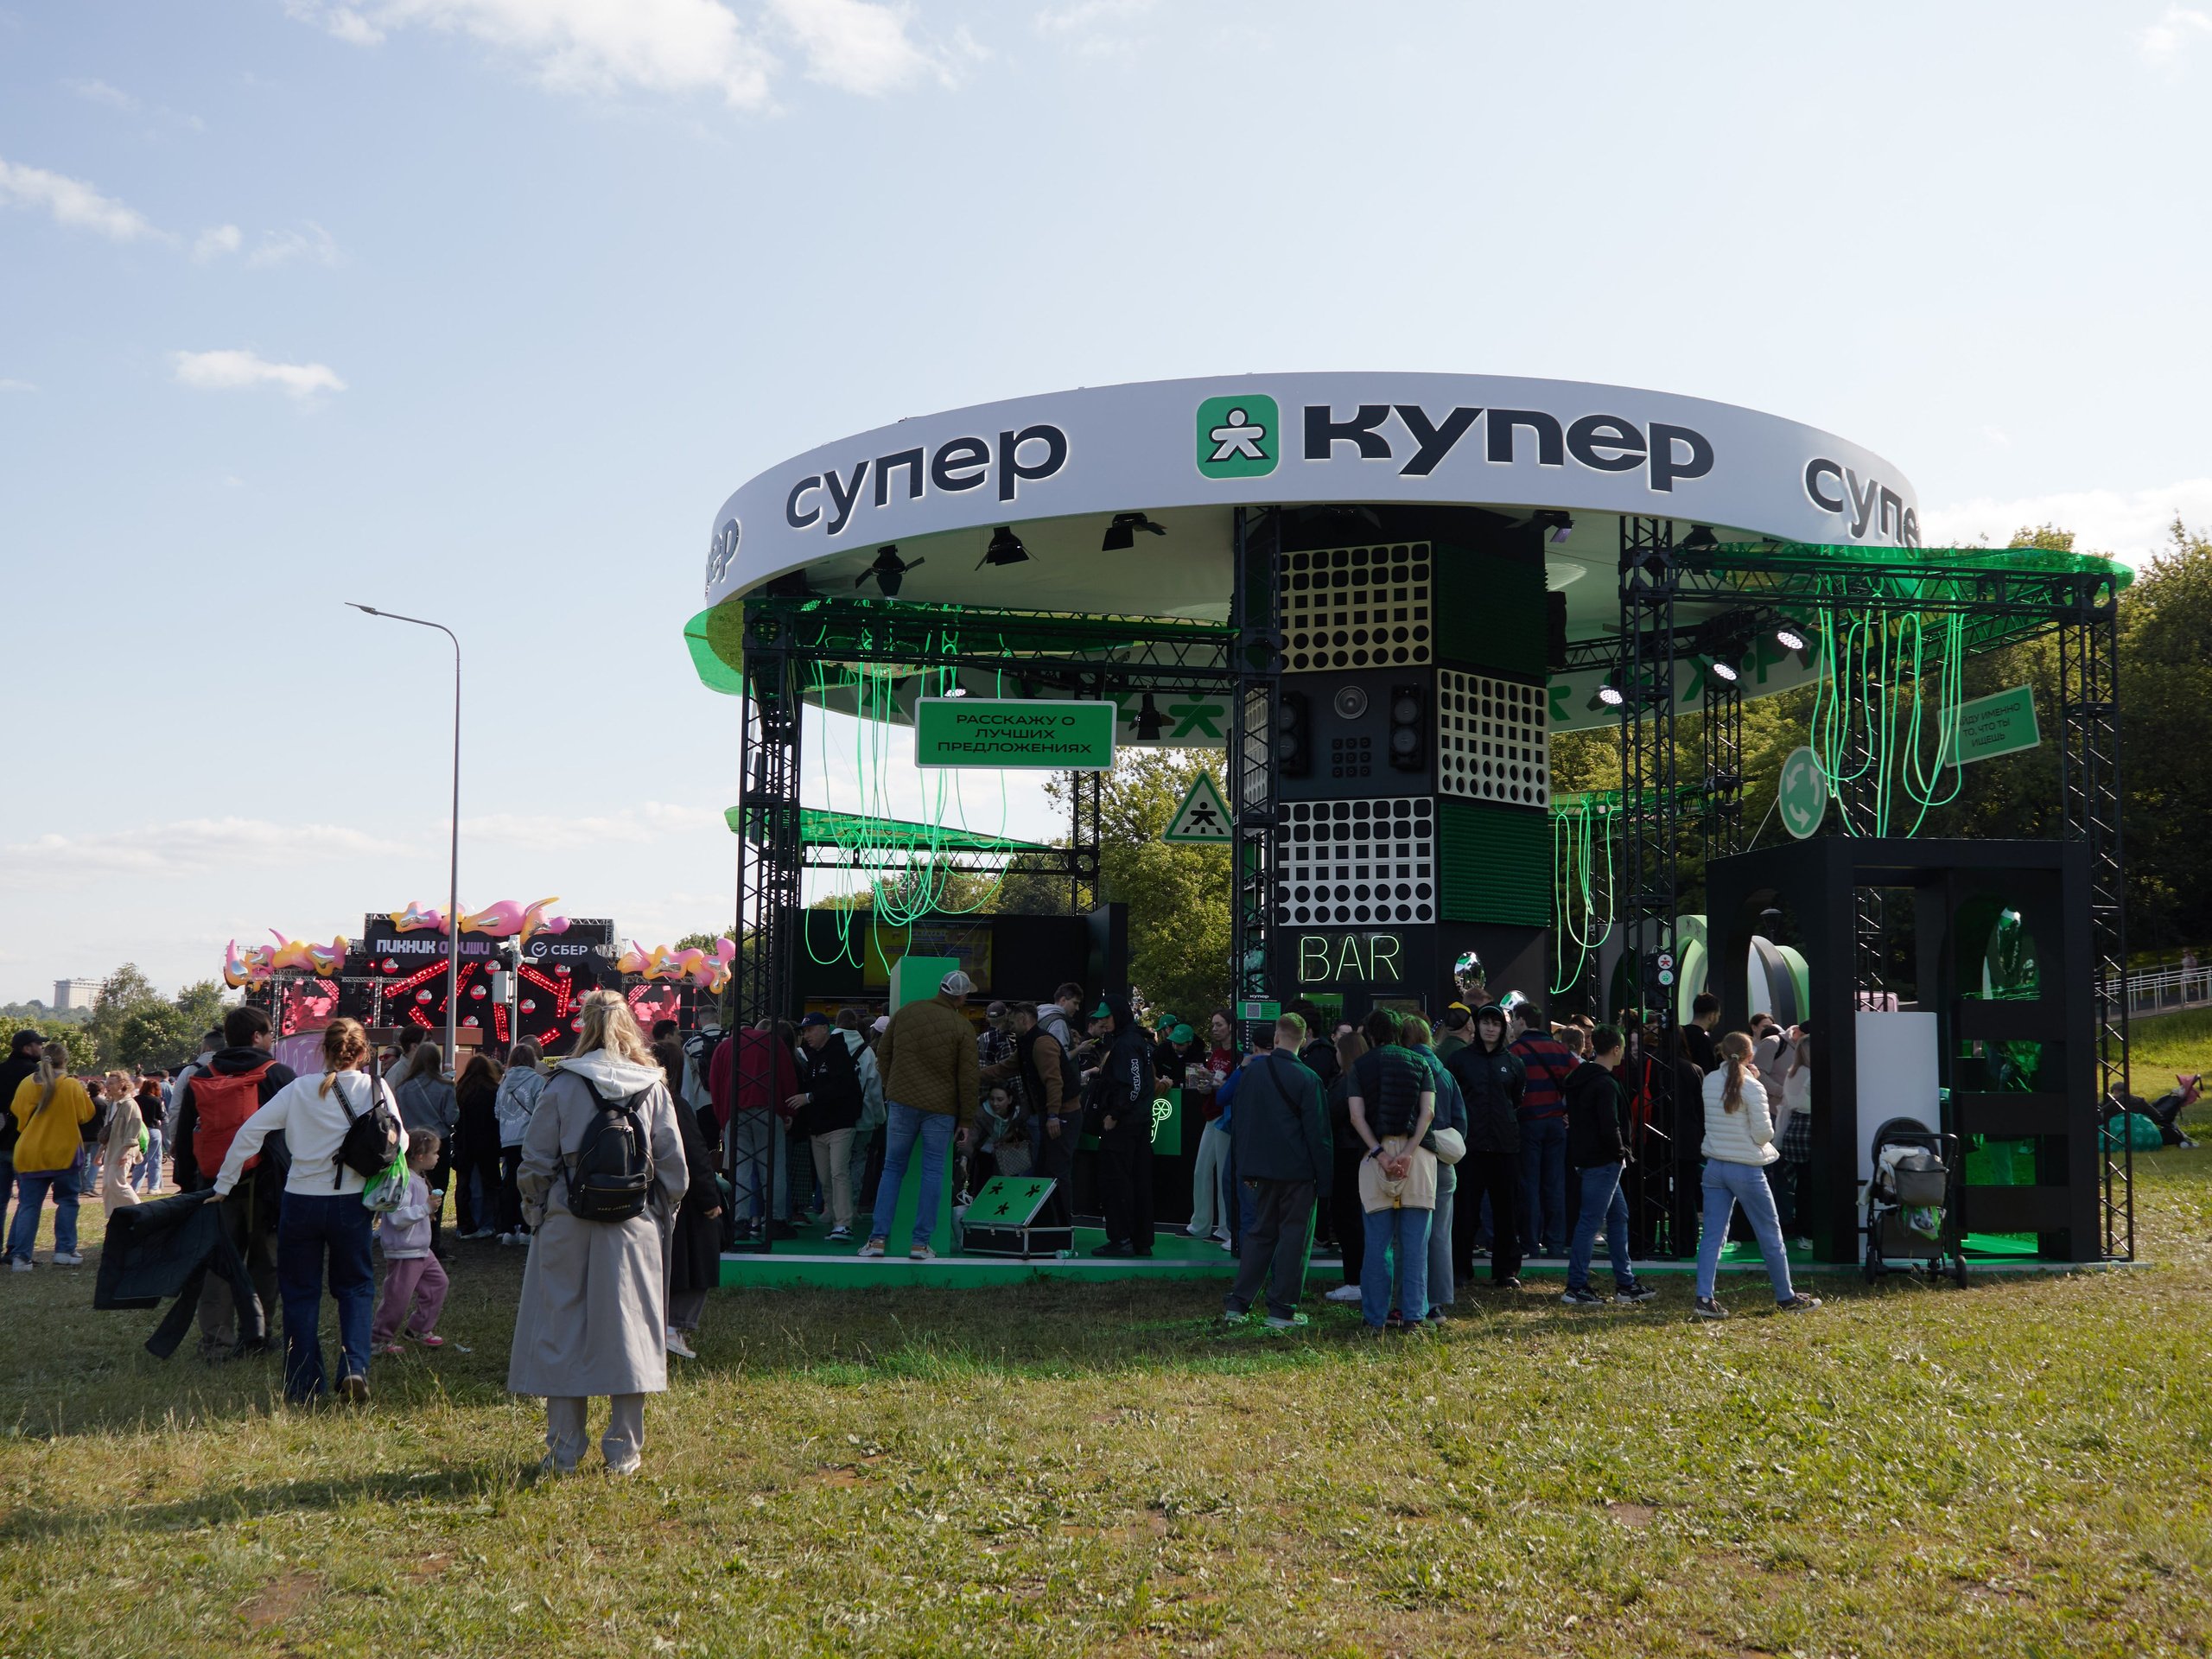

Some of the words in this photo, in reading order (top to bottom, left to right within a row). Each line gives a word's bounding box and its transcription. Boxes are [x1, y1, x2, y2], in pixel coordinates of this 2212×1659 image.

[1303, 404, 1715, 493] купер
[785, 423, 1070, 536] супер
[1805, 458, 1921, 559] супе
[957, 715, 1058, 725] РАССКАЖУ
[1061, 716, 1076, 726] О
[1950, 713, 1980, 728] НЙДУ
[1980, 702, 2021, 721] ИМЕННО
[975, 728, 1055, 739] ЛУЧШИХ
[1978, 721, 1996, 733] ЧТО
[1997, 718, 2011, 728] ТЫ
[938, 741, 1092, 753] ПРЕДЛОЖЕНИЯХ
[1971, 732, 2005, 747] ИЩЕШЬ
[439, 940, 491, 956] аиши
[550, 944, 588, 956] СБЕР
[1300, 935, 1400, 982] BAR
[1130, 1058, 1141, 1102] купер
